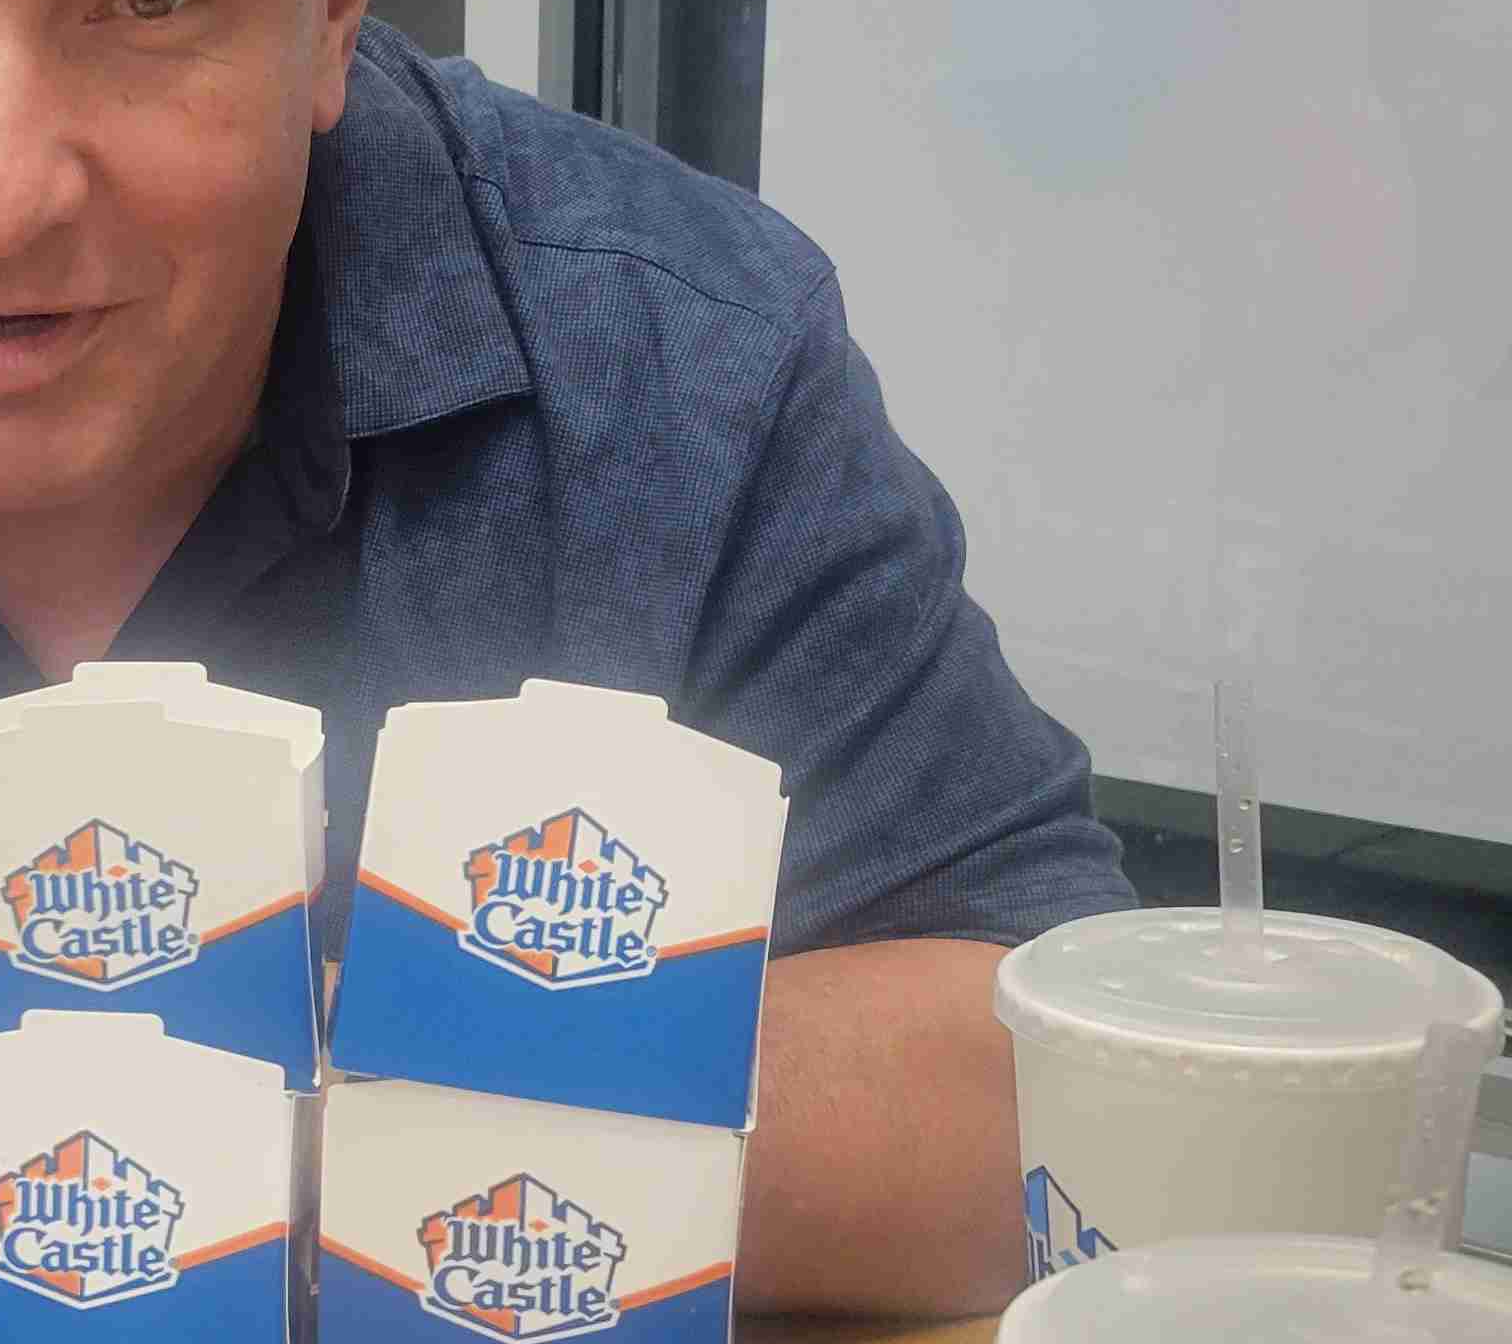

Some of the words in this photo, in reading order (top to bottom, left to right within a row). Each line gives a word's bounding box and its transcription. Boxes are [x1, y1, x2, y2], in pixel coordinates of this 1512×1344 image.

[29, 869, 174, 931] White
[489, 852, 643, 915] White
[21, 915, 186, 960] Castle
[475, 901, 645, 962] Castle
[14, 1177, 160, 1241] White
[3, 1227, 167, 1277] Castle
[446, 1220, 601, 1276] White
[433, 1265, 606, 1317] Castle
